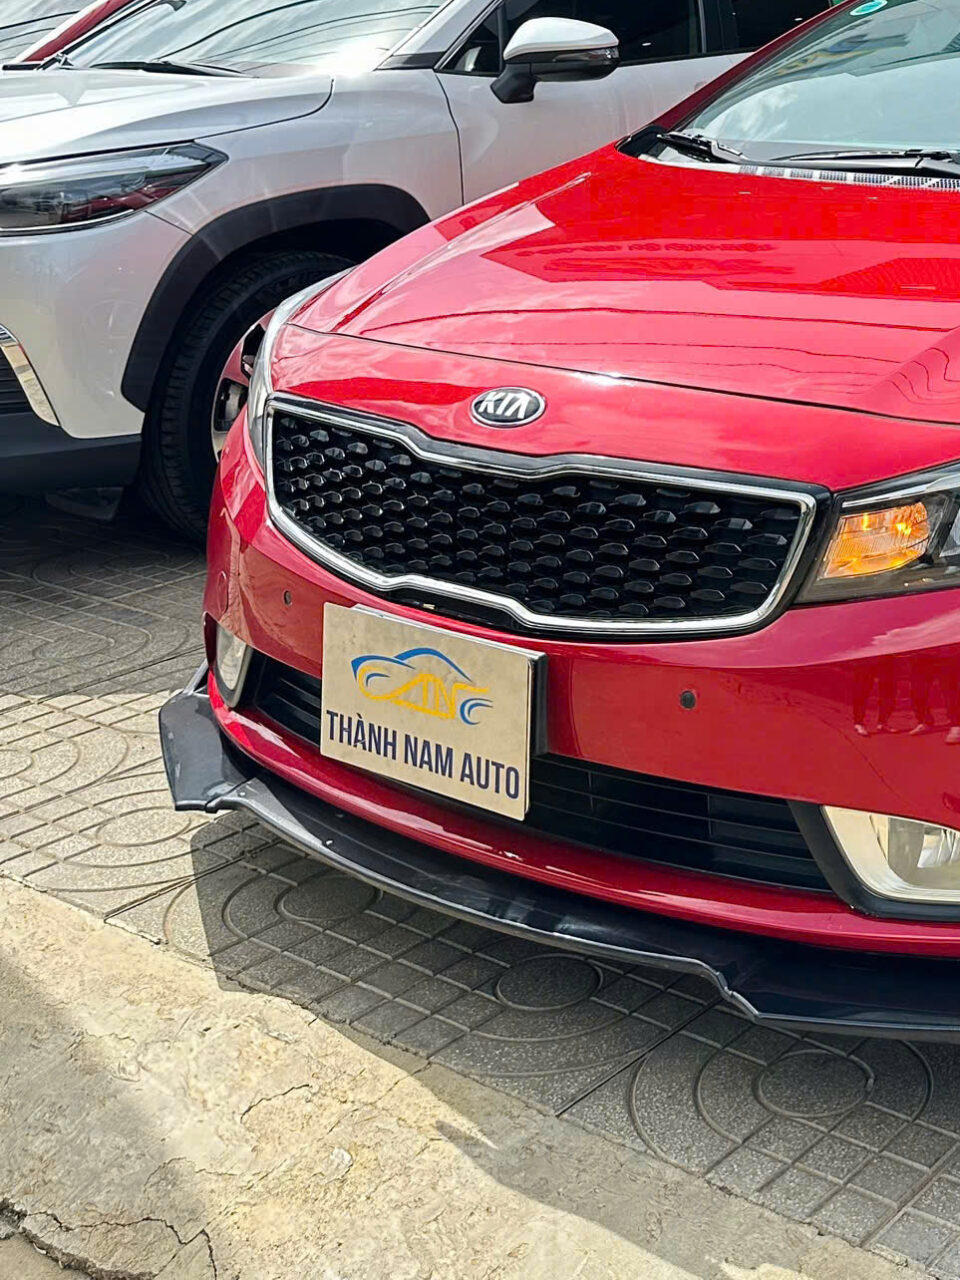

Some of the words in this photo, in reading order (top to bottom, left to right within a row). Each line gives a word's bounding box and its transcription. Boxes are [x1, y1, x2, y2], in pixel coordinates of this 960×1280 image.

[478, 391, 531, 419] KIA
[326, 709, 397, 760] THÀNH
[404, 733, 454, 778] NAM
[459, 752, 520, 800] AUTO
